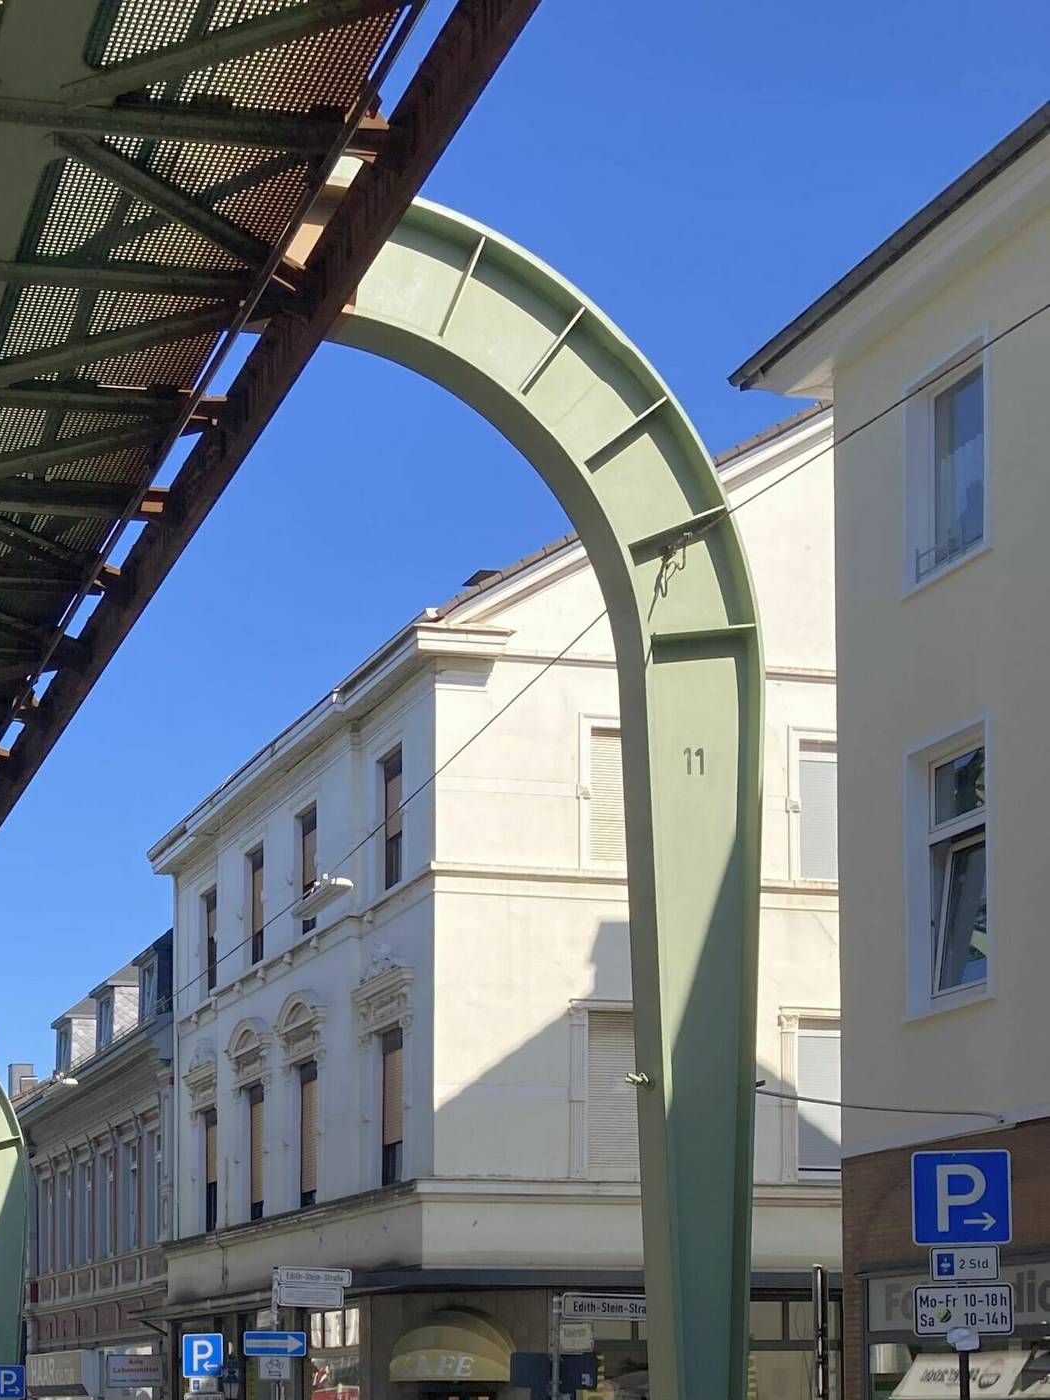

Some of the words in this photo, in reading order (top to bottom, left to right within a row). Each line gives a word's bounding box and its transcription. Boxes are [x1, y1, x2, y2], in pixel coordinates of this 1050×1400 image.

[682, 746, 705, 776] 11
[935, 1163, 987, 1234] P
[958, 1259, 966, 1270] 2
[969, 1258, 989, 1270] Std
[573, 1300, 646, 1315] Edith-Stein-Stra
[919, 1293, 958, 1309] Mo-Fr
[920, 1314, 935, 1327] Sa
[192, 1339, 214, 1372] P
[0, 1369, 18, 1395] P
